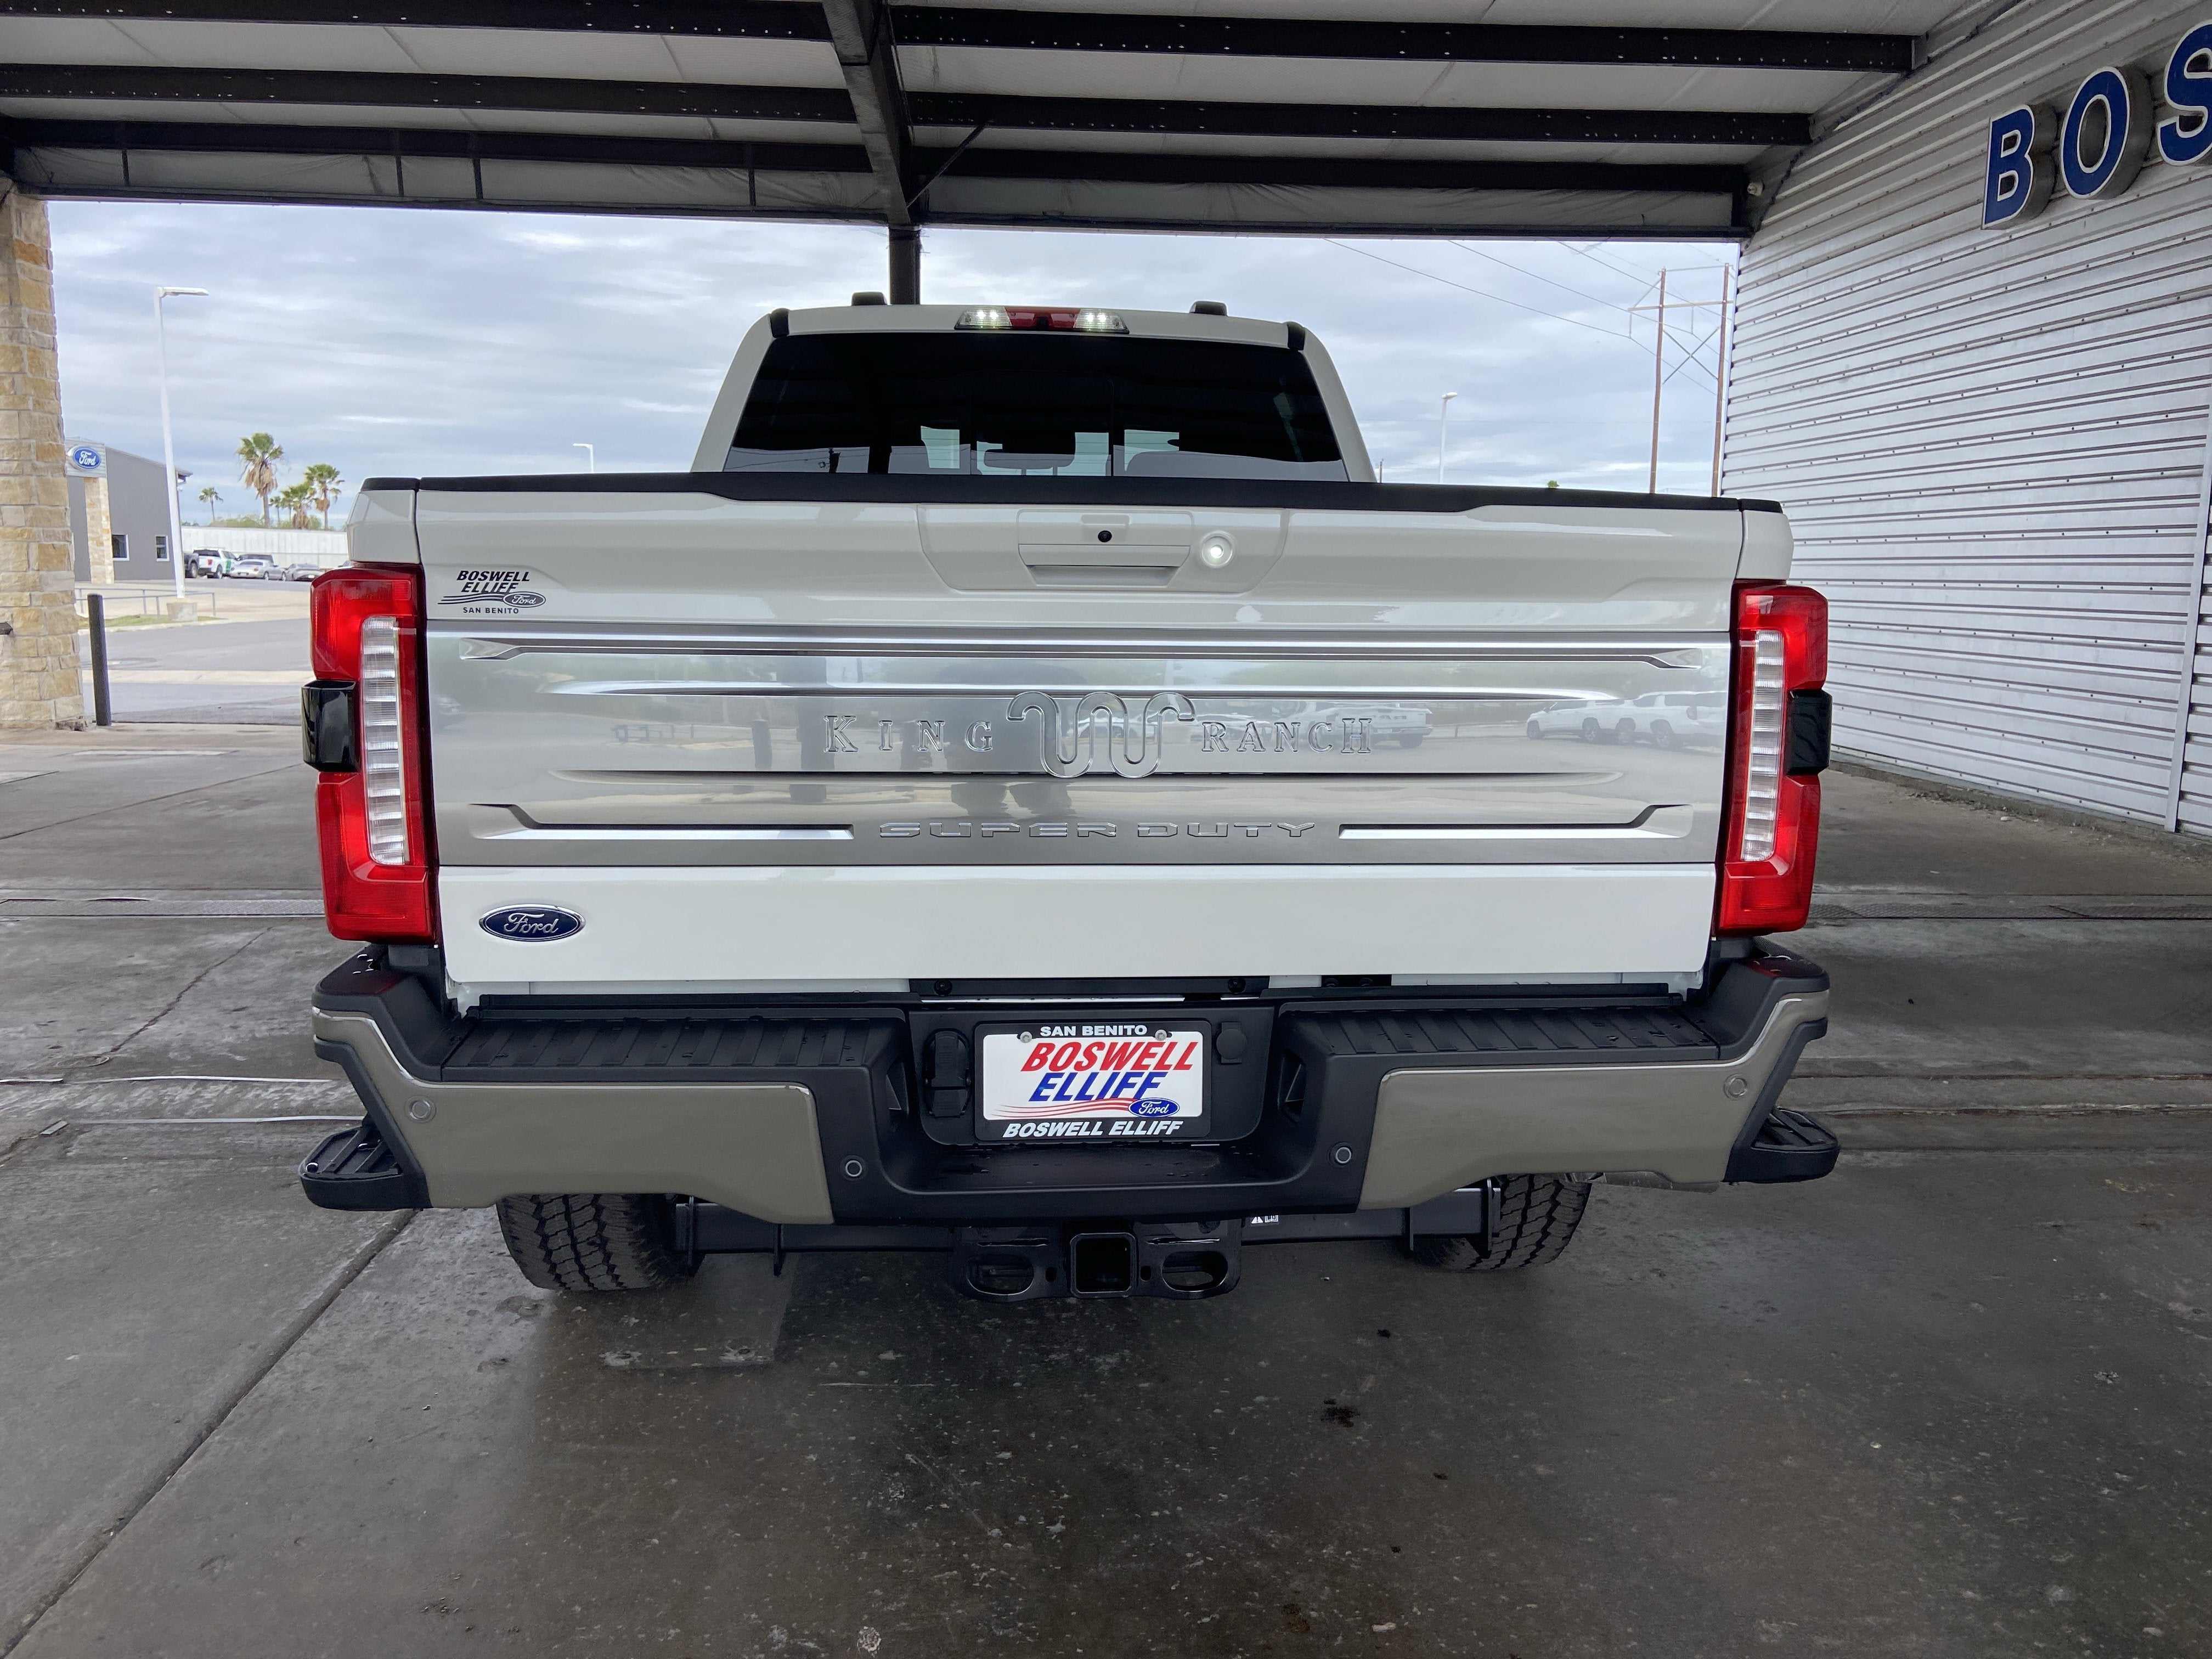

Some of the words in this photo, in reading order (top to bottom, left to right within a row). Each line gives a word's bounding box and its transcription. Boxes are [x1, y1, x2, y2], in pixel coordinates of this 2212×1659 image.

[1982, 19, 2212, 229] BOS
[78, 450, 97, 466] Ford
[456, 570, 530, 582] BOSWELL
[461, 582, 519, 593] ELLIFF
[511, 594, 537, 605] Ford
[823, 715, 993, 753] KING
[1201, 717, 1373, 754] RANCH
[879, 822, 1117, 838] SUPER
[1137, 822, 1315, 838] DUTY
[503, 912, 559, 934] Ford
[1040, 1025, 1076, 1036] SAN
[1082, 1025, 1148, 1036] BENITO
[1020, 1041, 1198, 1072] BOSWELL
[1028, 1071, 1168, 1102] ELLIFF
[1138, 1101, 1169, 1115] Ford
[1002, 1121, 1103, 1138] BOSWELL
[1108, 1120, 1184, 1136] ELLIFF
